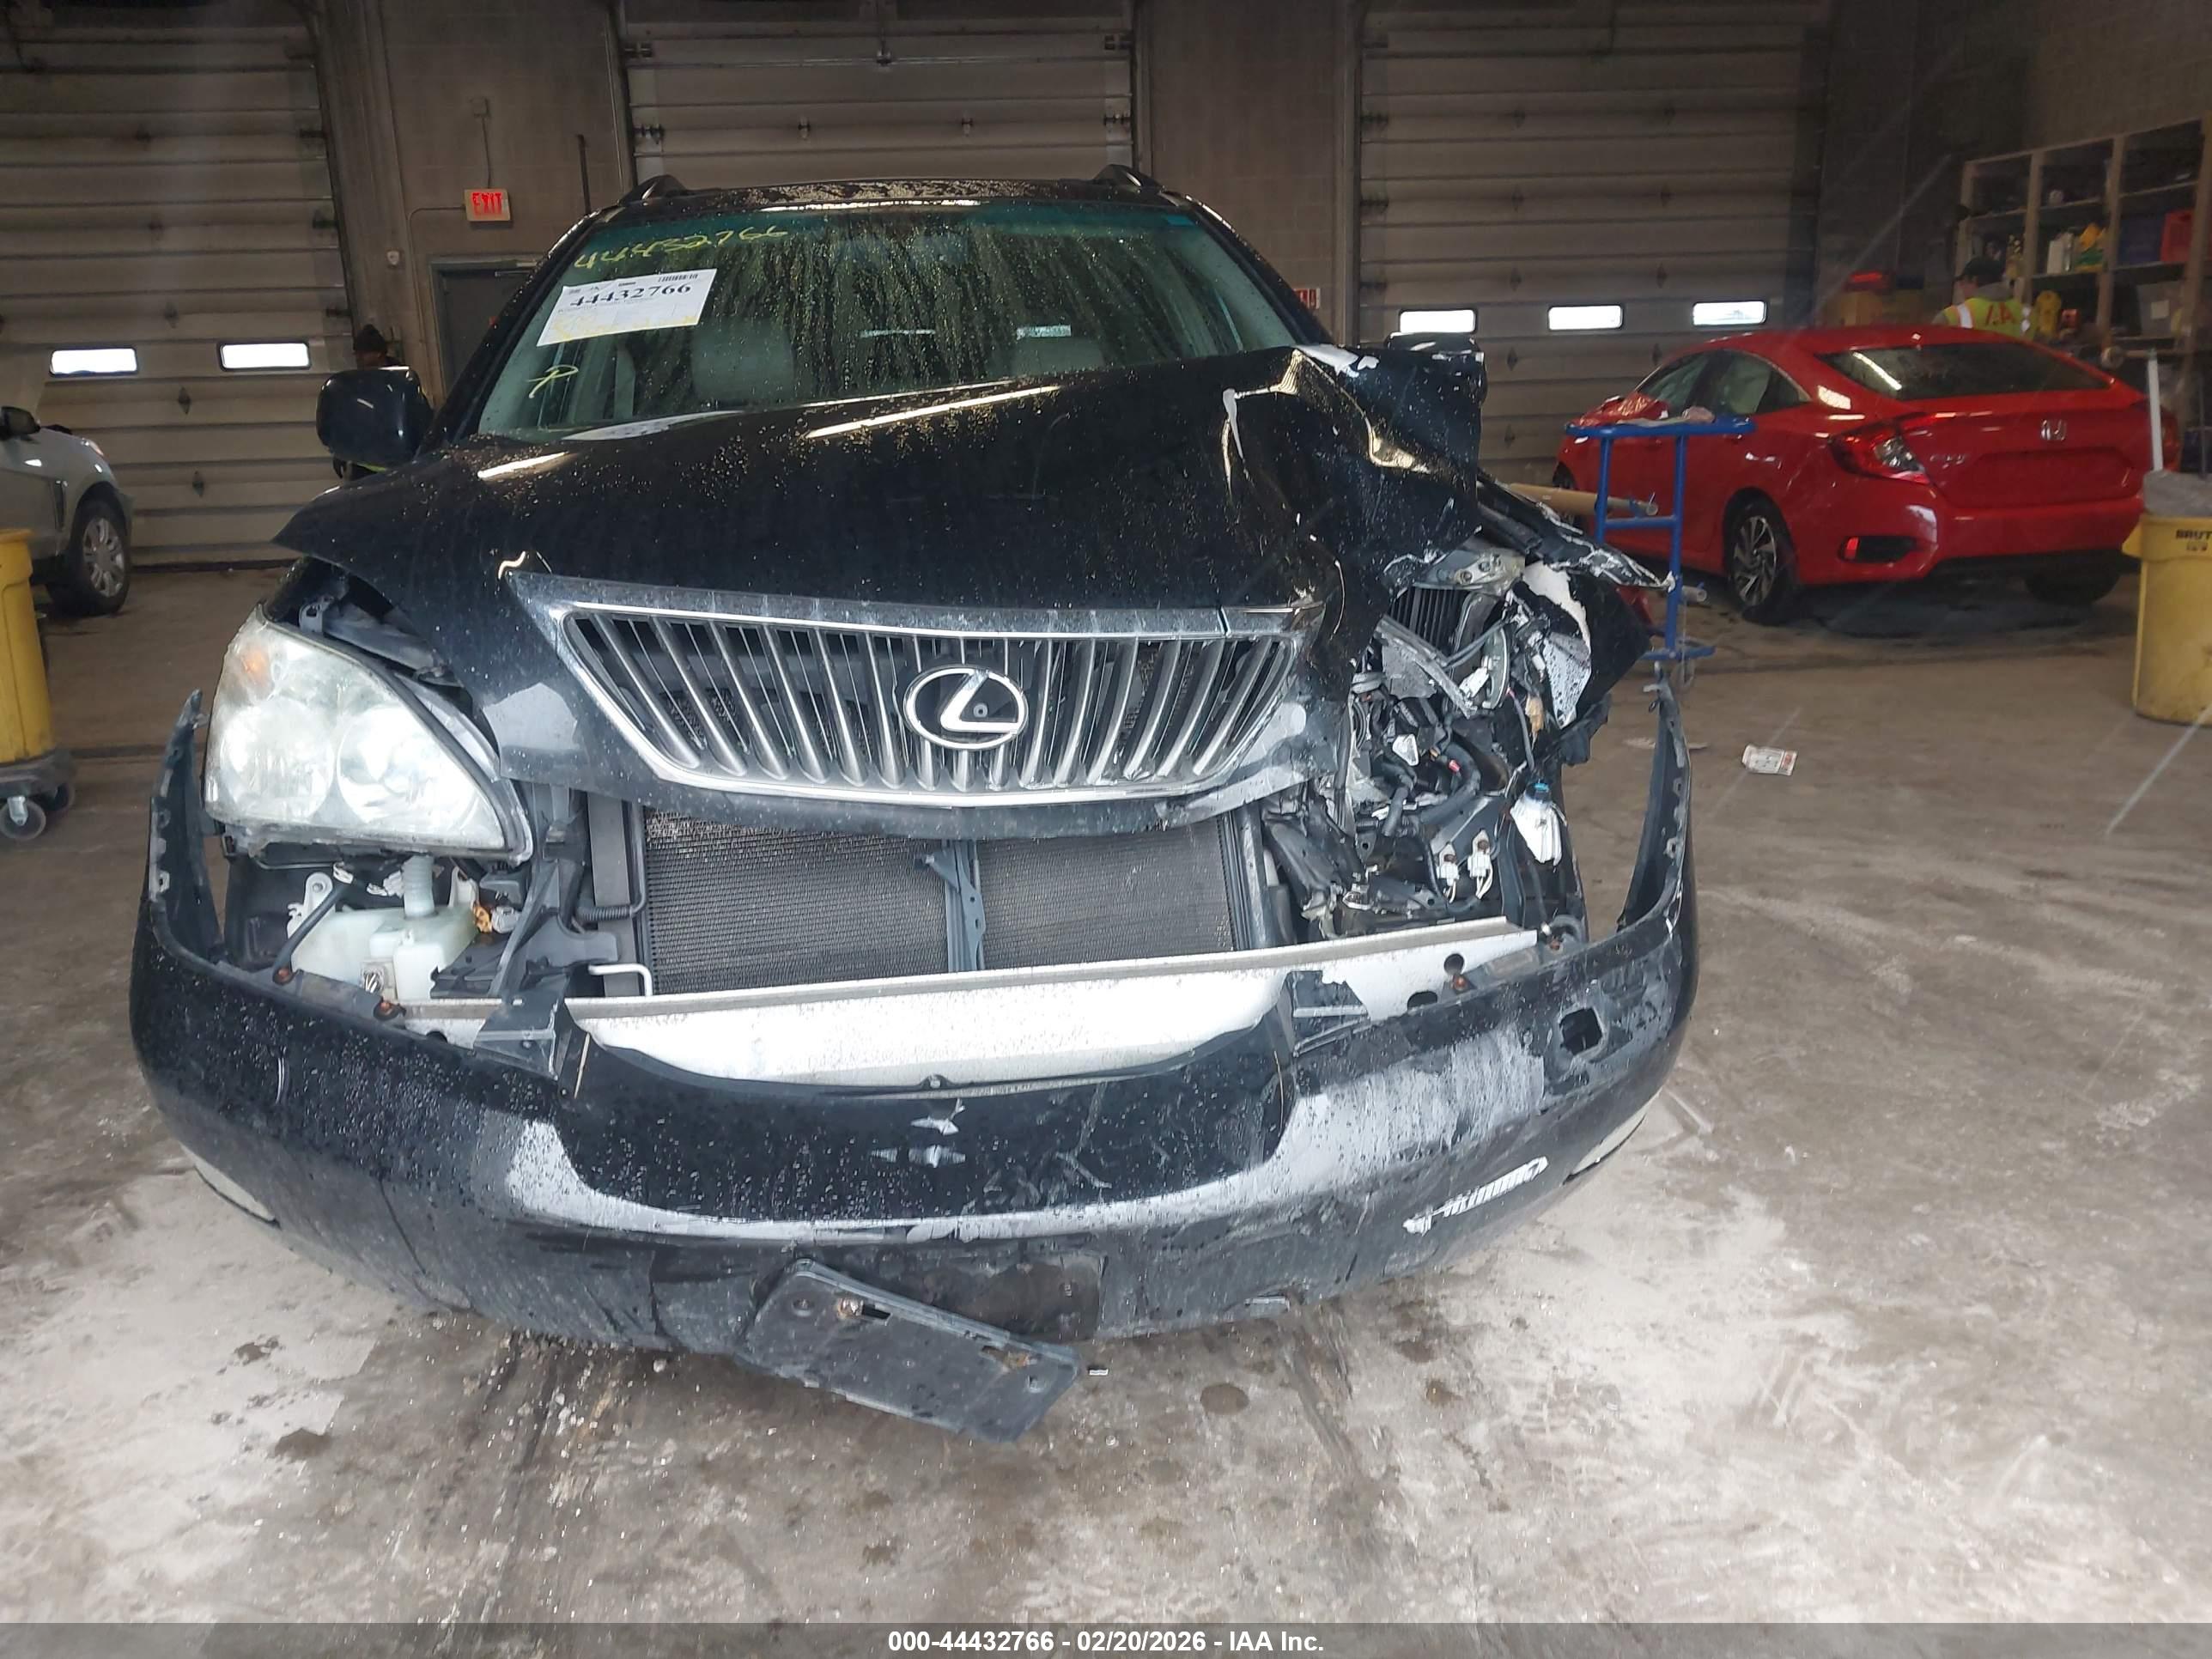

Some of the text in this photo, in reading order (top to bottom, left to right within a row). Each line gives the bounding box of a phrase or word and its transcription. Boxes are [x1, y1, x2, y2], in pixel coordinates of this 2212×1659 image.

[471, 191, 502, 215] EXIT
[574, 225, 788, 269] 44432766
[570, 283, 691, 307] 44432766
